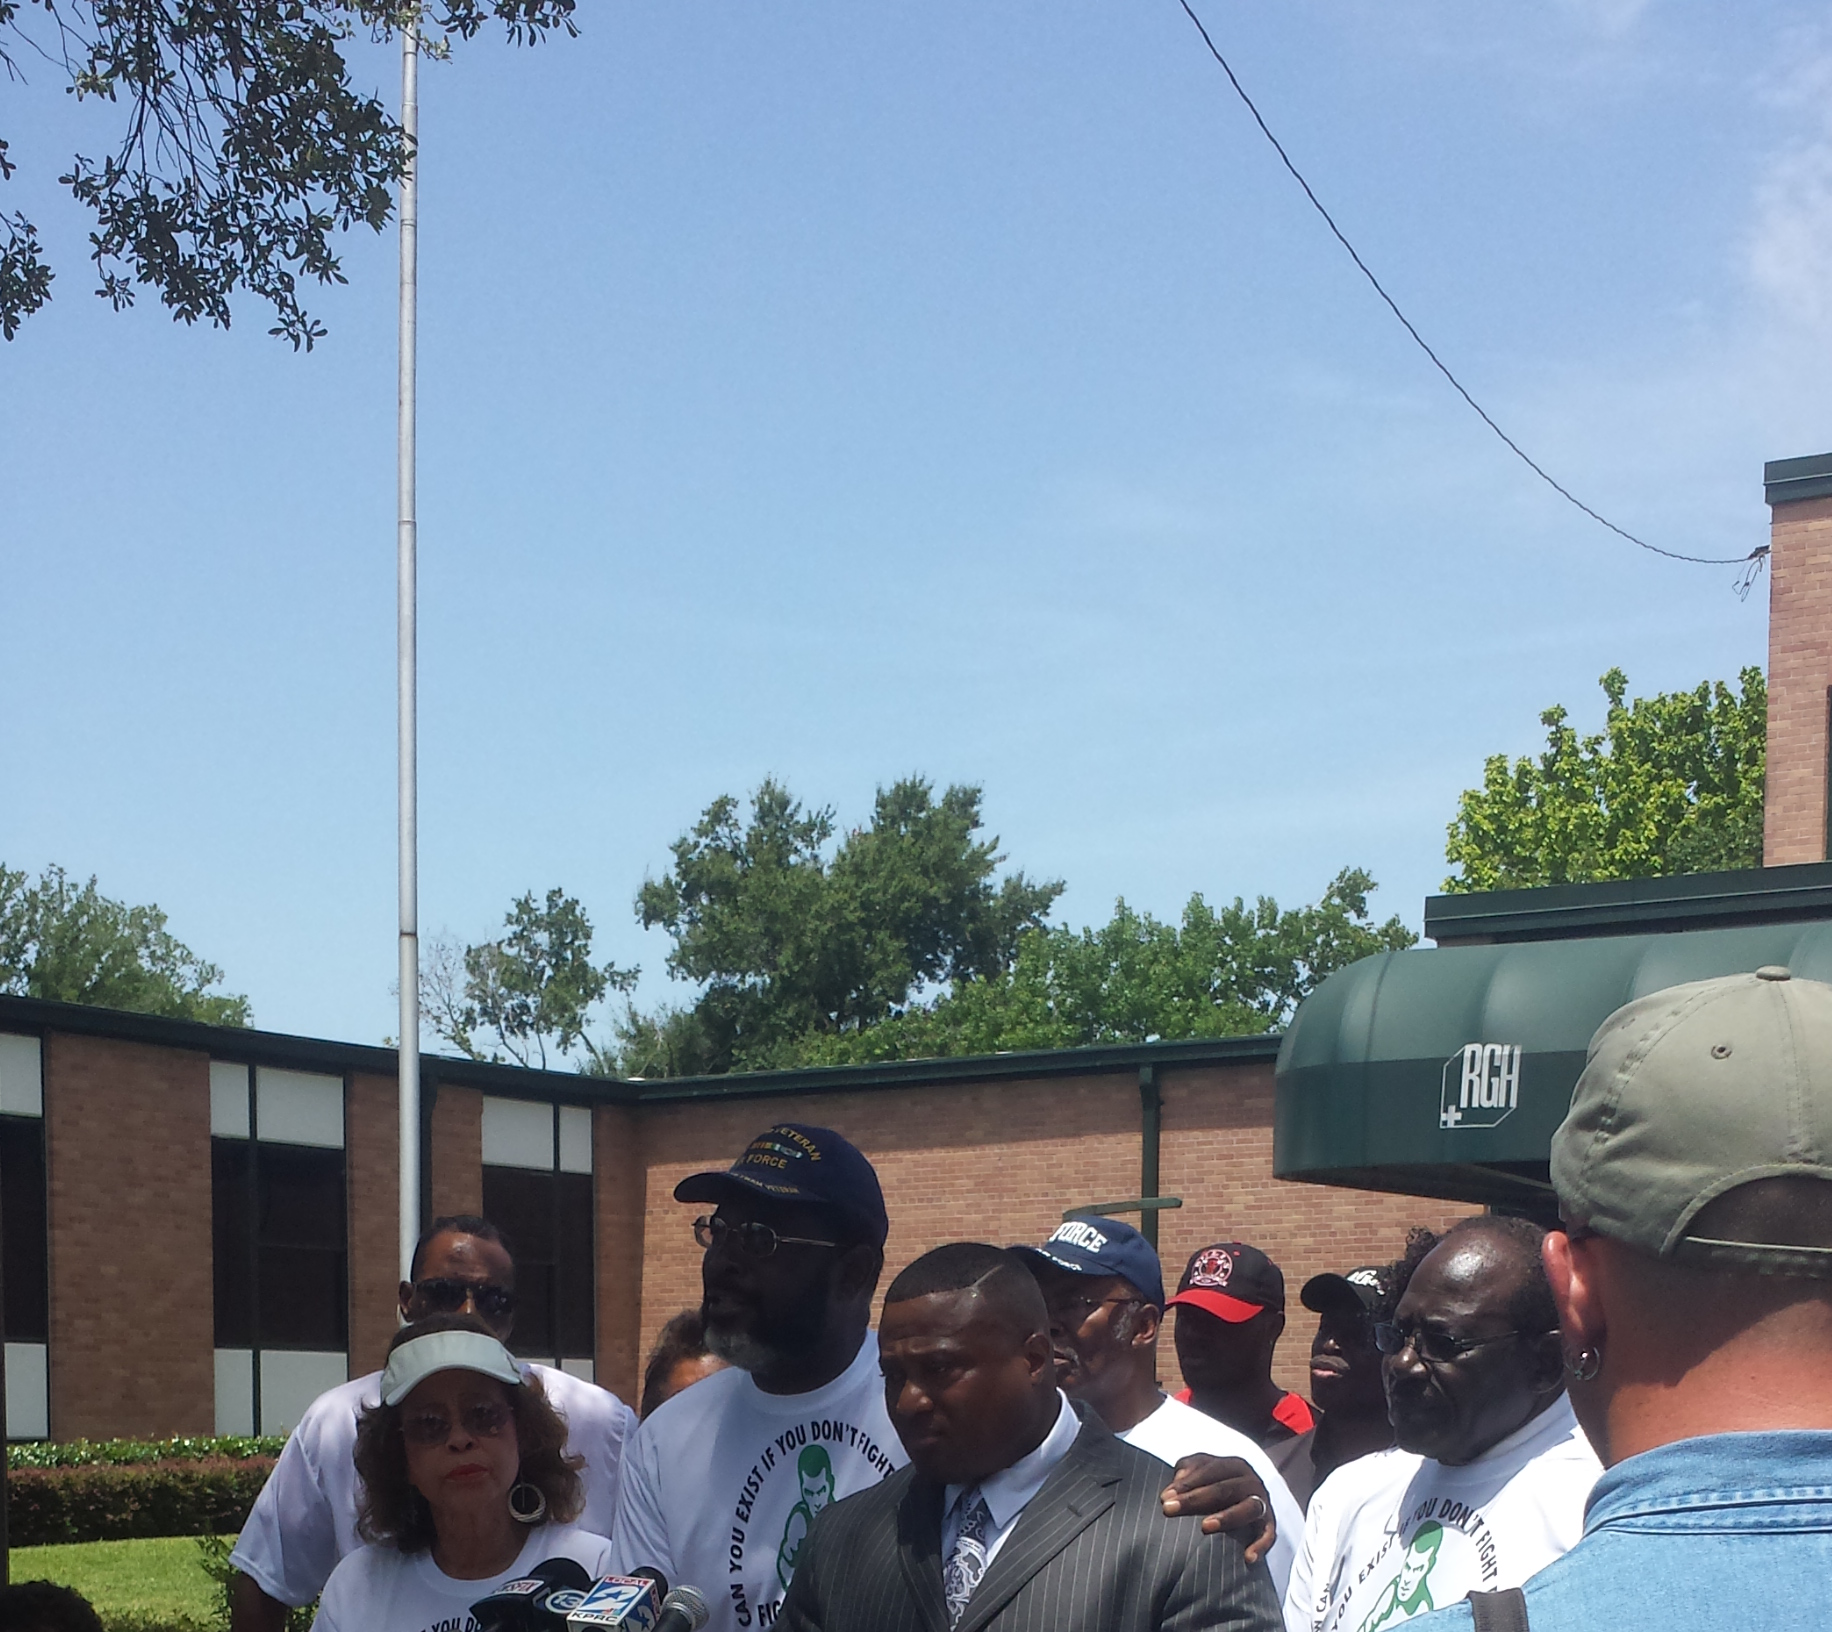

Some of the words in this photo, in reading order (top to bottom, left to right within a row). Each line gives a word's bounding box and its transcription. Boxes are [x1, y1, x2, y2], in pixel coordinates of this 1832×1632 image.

[1460, 1043, 1522, 1109] RGH
[1048, 1221, 1109, 1254] FORCE
[775, 1424, 806, 1457] YOU
[811, 1420, 858, 1446] DON'T
[761, 1446, 776, 1471] IF
[856, 1431, 896, 1478] FIGHT
[735, 1465, 765, 1524] EXIST
[729, 1527, 746, 1574] YOU
[1475, 1530, 1498, 1582] FIGHT
[604, 1574, 652, 1587] LOCAL
[579, 1585, 640, 1612] 2
[571, 1610, 620, 1623] KPRC
